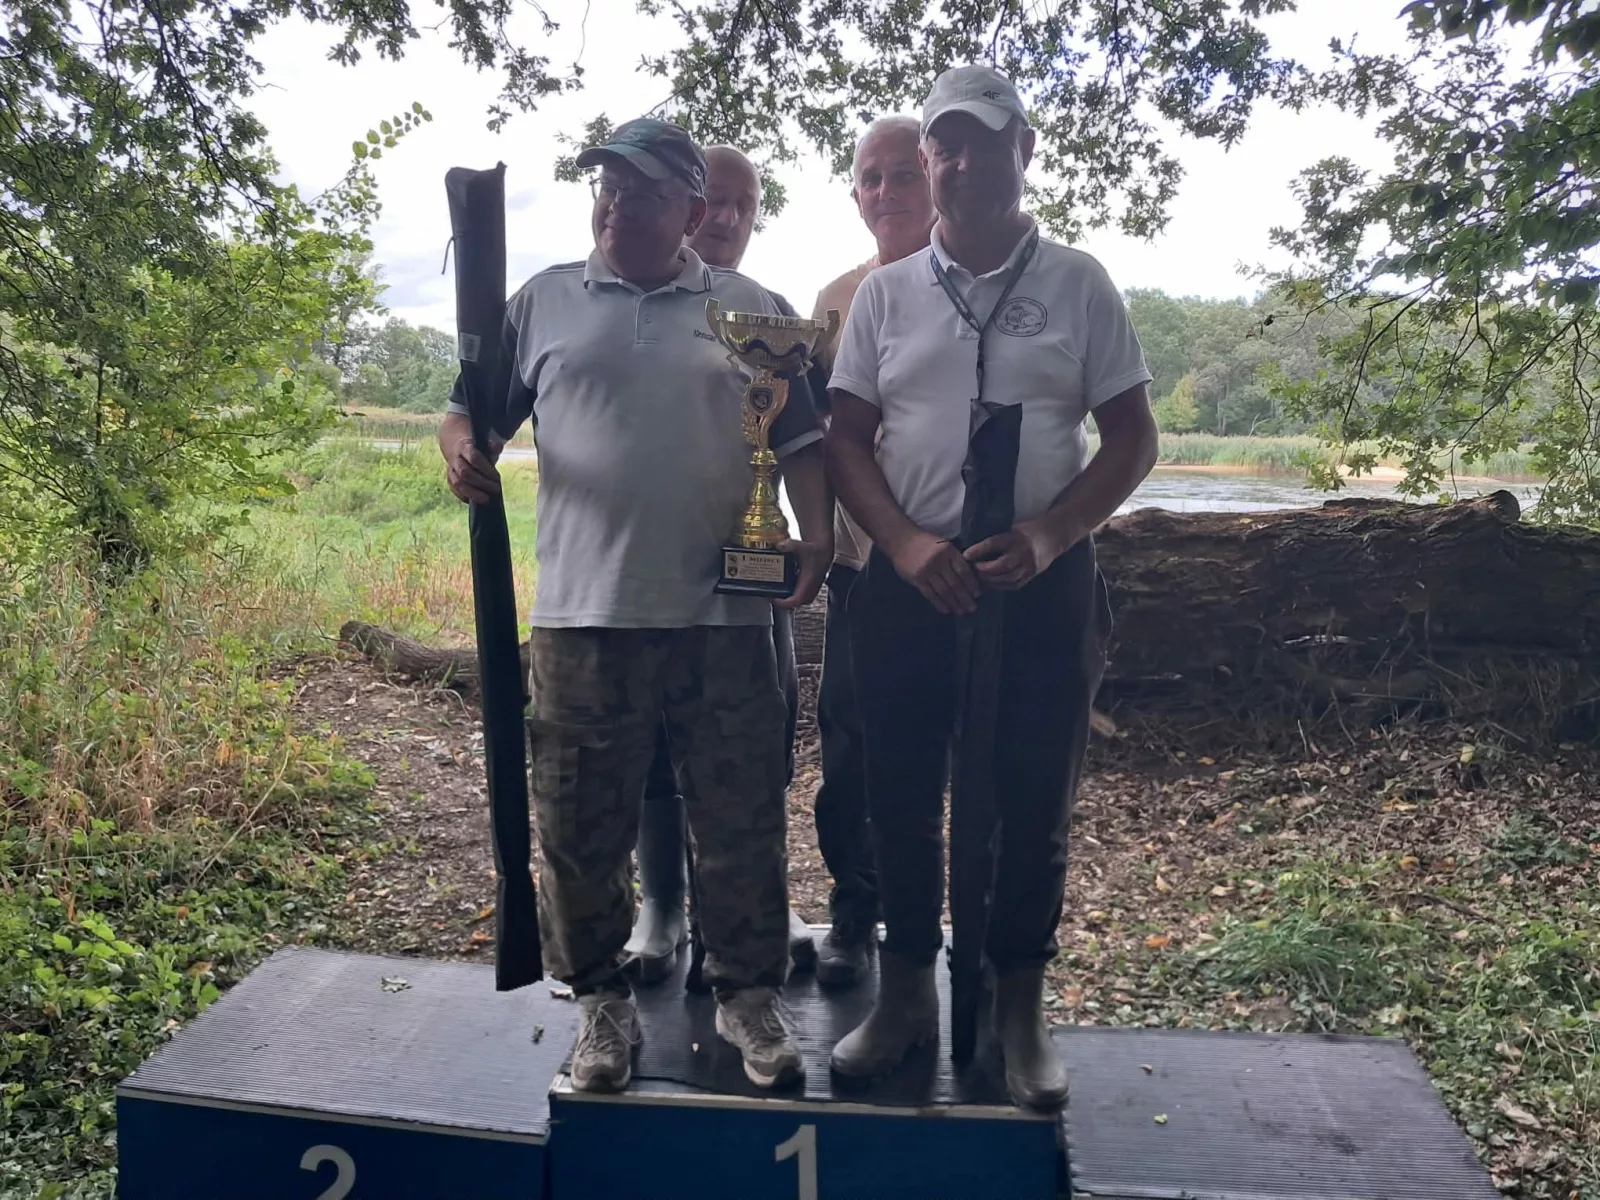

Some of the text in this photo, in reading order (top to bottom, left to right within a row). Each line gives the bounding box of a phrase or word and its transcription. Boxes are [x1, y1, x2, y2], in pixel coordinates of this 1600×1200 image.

[982, 90, 1001, 100] 4F
[300, 1144, 356, 1200] 2
[775, 1124, 818, 1200] 1
